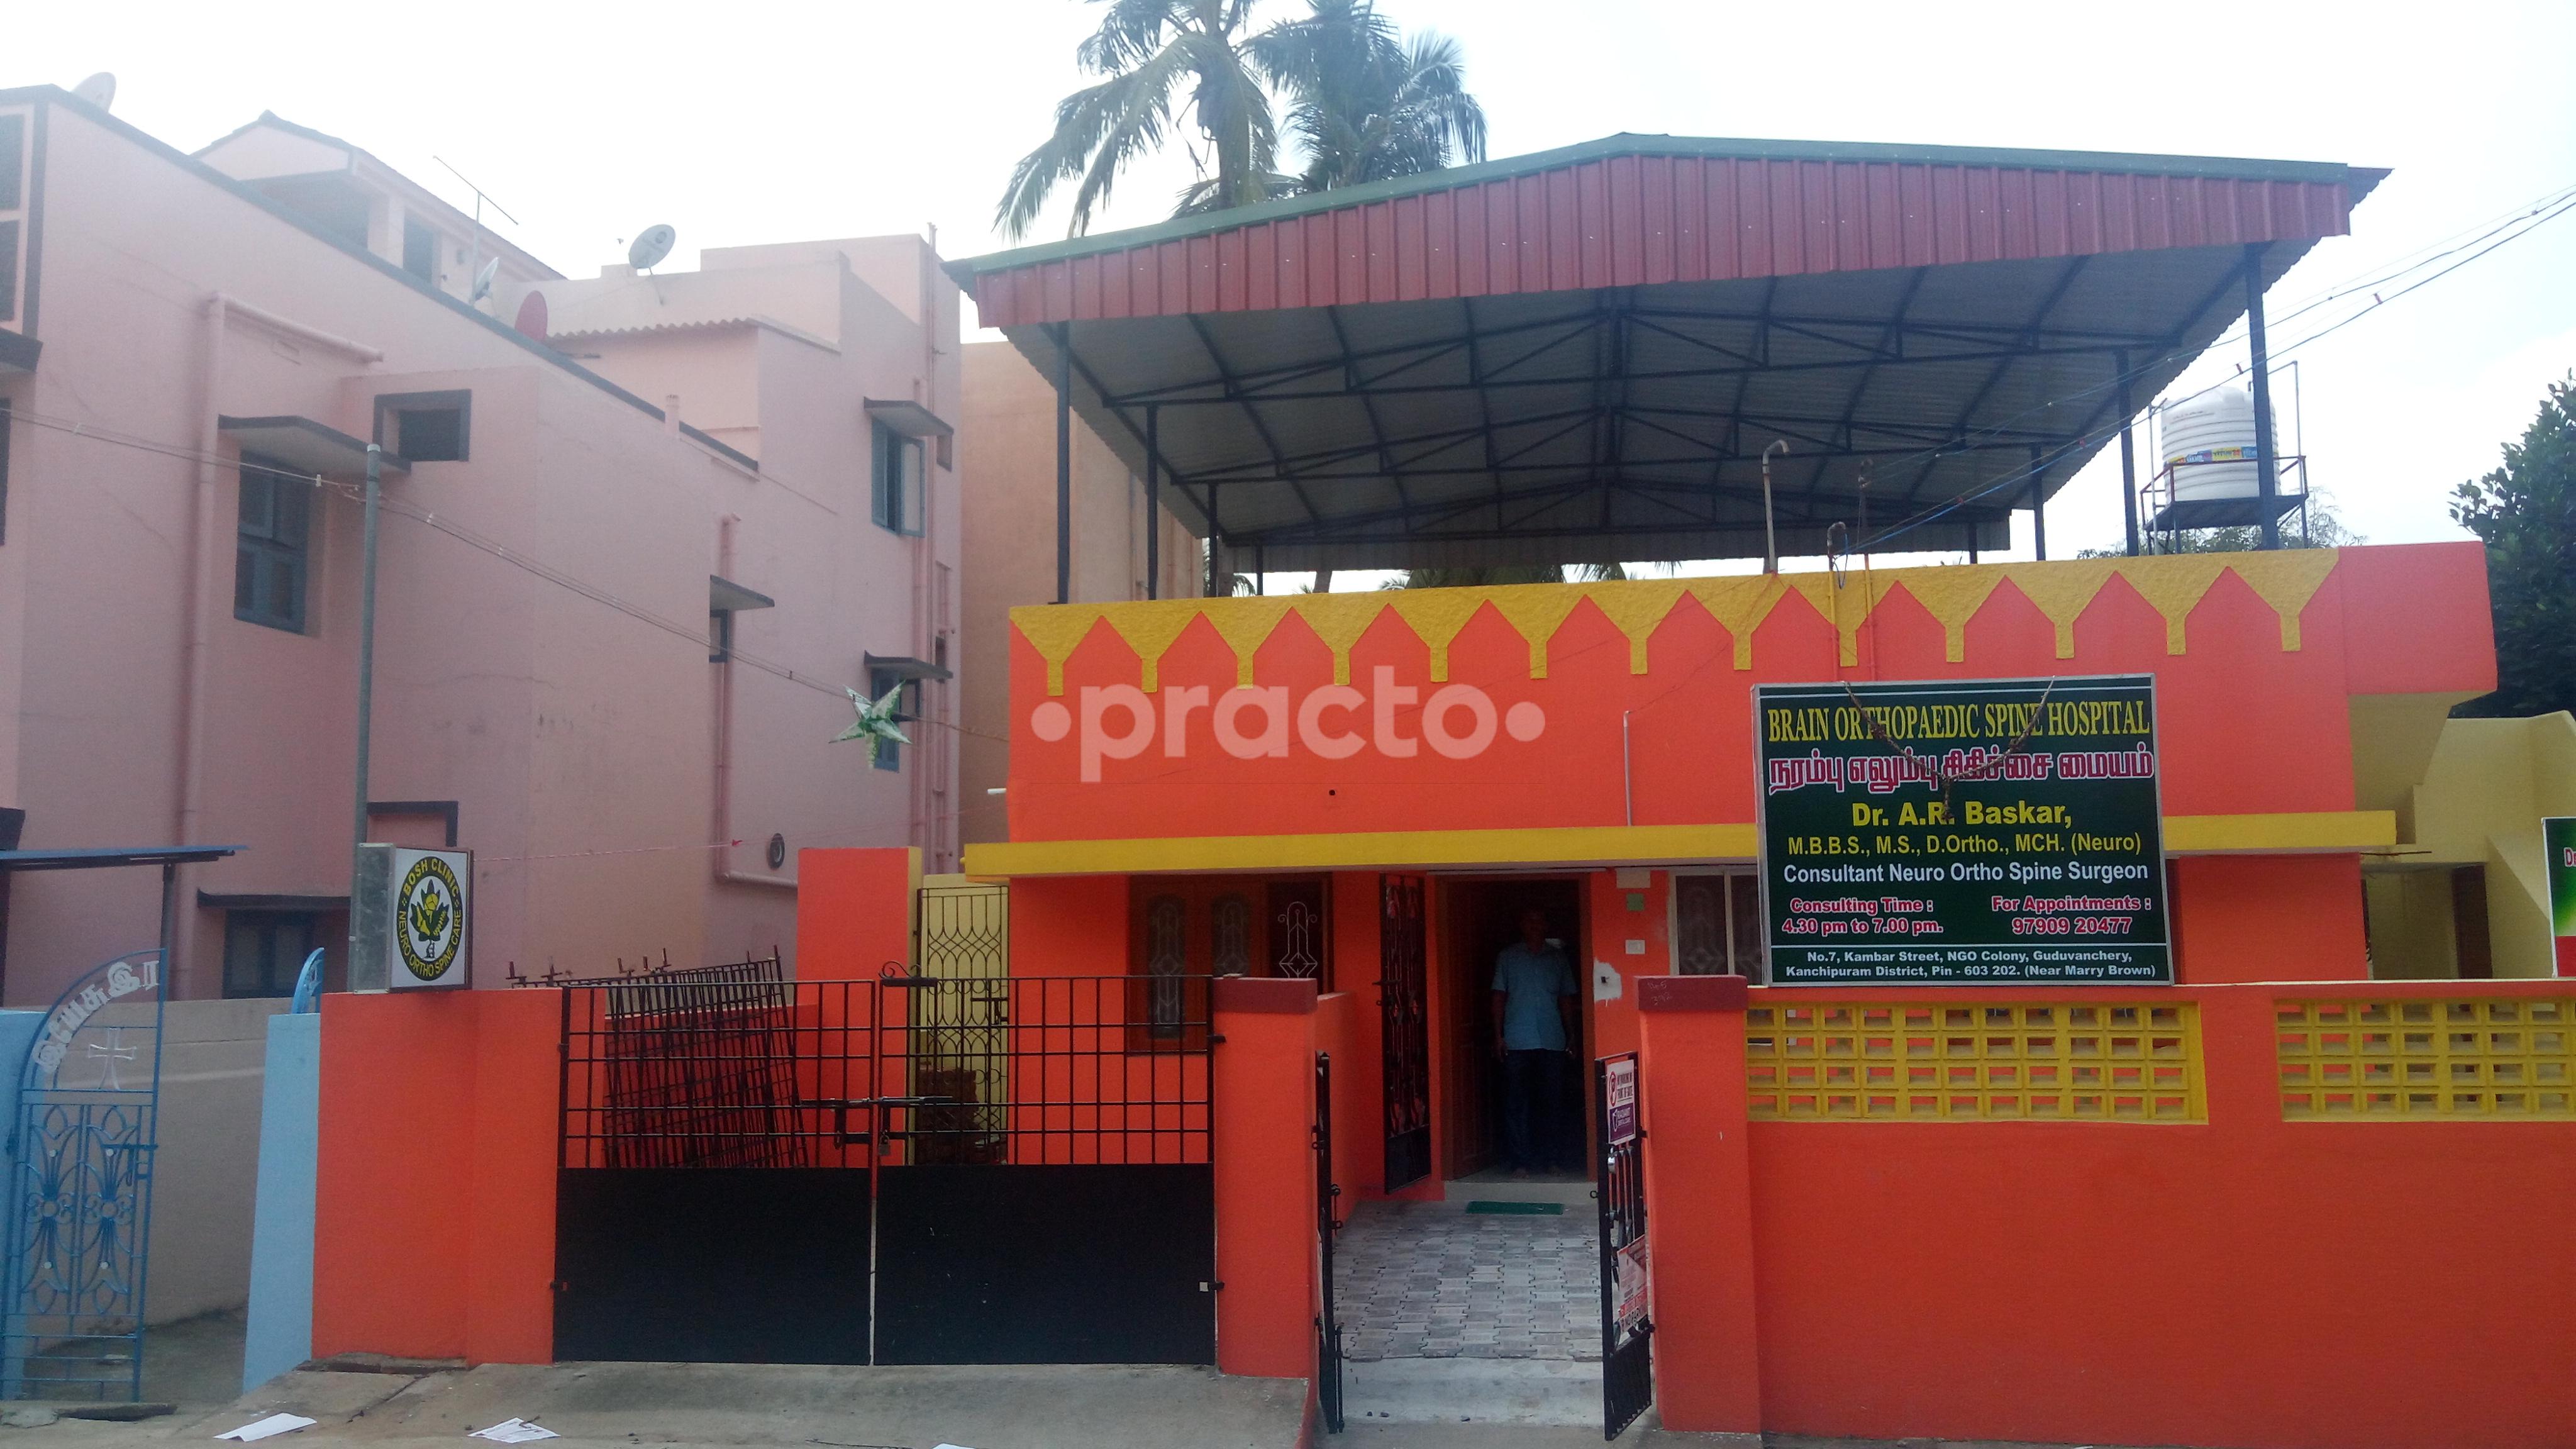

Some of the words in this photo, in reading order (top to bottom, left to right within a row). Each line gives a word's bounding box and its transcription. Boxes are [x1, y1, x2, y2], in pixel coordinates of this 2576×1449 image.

[1767, 708, 1829, 742] BRAIN
[1834, 704, 1980, 741] ORTHOPAEDIC
[1985, 701, 2043, 738] SPINE
[2046, 700, 2150, 736] HOSPITAL
[1768, 748, 1845, 796] நரம்பு
[1847, 746, 1938, 794] எலும்பு
[1941, 744, 2054, 782] சிகிச்சை
[2057, 741, 2155, 780] மையம்
[1852, 802, 1889, 826] Dr.
[1898, 801, 1955, 826] A.R.
[1965, 800, 2072, 829] Baskar,
[1788, 836, 1870, 858] M.B.B.S.,
[1876, 835, 1921, 857] M.S.,
[1926, 834, 2009, 855] D.Ortho.,
[2016, 833, 2065, 853] MCH.
[2071, 832, 2141, 856] (Neuro)
[402, 859, 428, 896] BOSH
[431, 858, 460, 897] CLINIC
[1784, 863, 1884, 883] Consultant
[1889, 863, 1945, 882] Neuro
[1950, 862, 2004, 881] Ortho
[2009, 862, 2063, 884] Spine
[2068, 861, 2149, 884] Surgeon
[1790, 897, 1878, 916] Consulting
[1881, 897, 1924, 913] Time
[1992, 896, 2020, 912] For
[2023, 894, 2141, 914] Appointments
[1782, 918, 1818, 933] 4.30
[1821, 921, 1848, 937] pm
[1851, 918, 1869, 933] to
[1872, 917, 1909, 933] 7.00
[1912, 920, 1944, 936] pm.
[2012, 916, 2070, 935] 97909
[2074, 916, 2133, 934] 20477
[397, 911, 412, 956] NEURO
[409, 953, 435, 977] ORTHO
[435, 948, 455, 974] SPINE
[450, 909, 462, 945] CARE
[1807, 952, 1841, 963] No.7,
[1844, 951, 1896, 962] Kambar
[1898, 950, 1944, 963] Street,
[1946, 950, 1977, 962] NGO
[1980, 950, 2029, 963] Colony,
[2033, 950, 2133, 963] Guduvanchery,
[1786, 966, 1872, 979] Kanchipuram
[1875, 965, 1928, 977] District,
[1931, 965, 1952, 976] Pin
[1963, 965, 1989, 976] 603
[1992, 965, 2021, 975] 202.
[2024, 964, 2062, 978] (Near
[2065, 964, 2104, 978] Marry
[2107, 963, 2156, 977] Brown)
